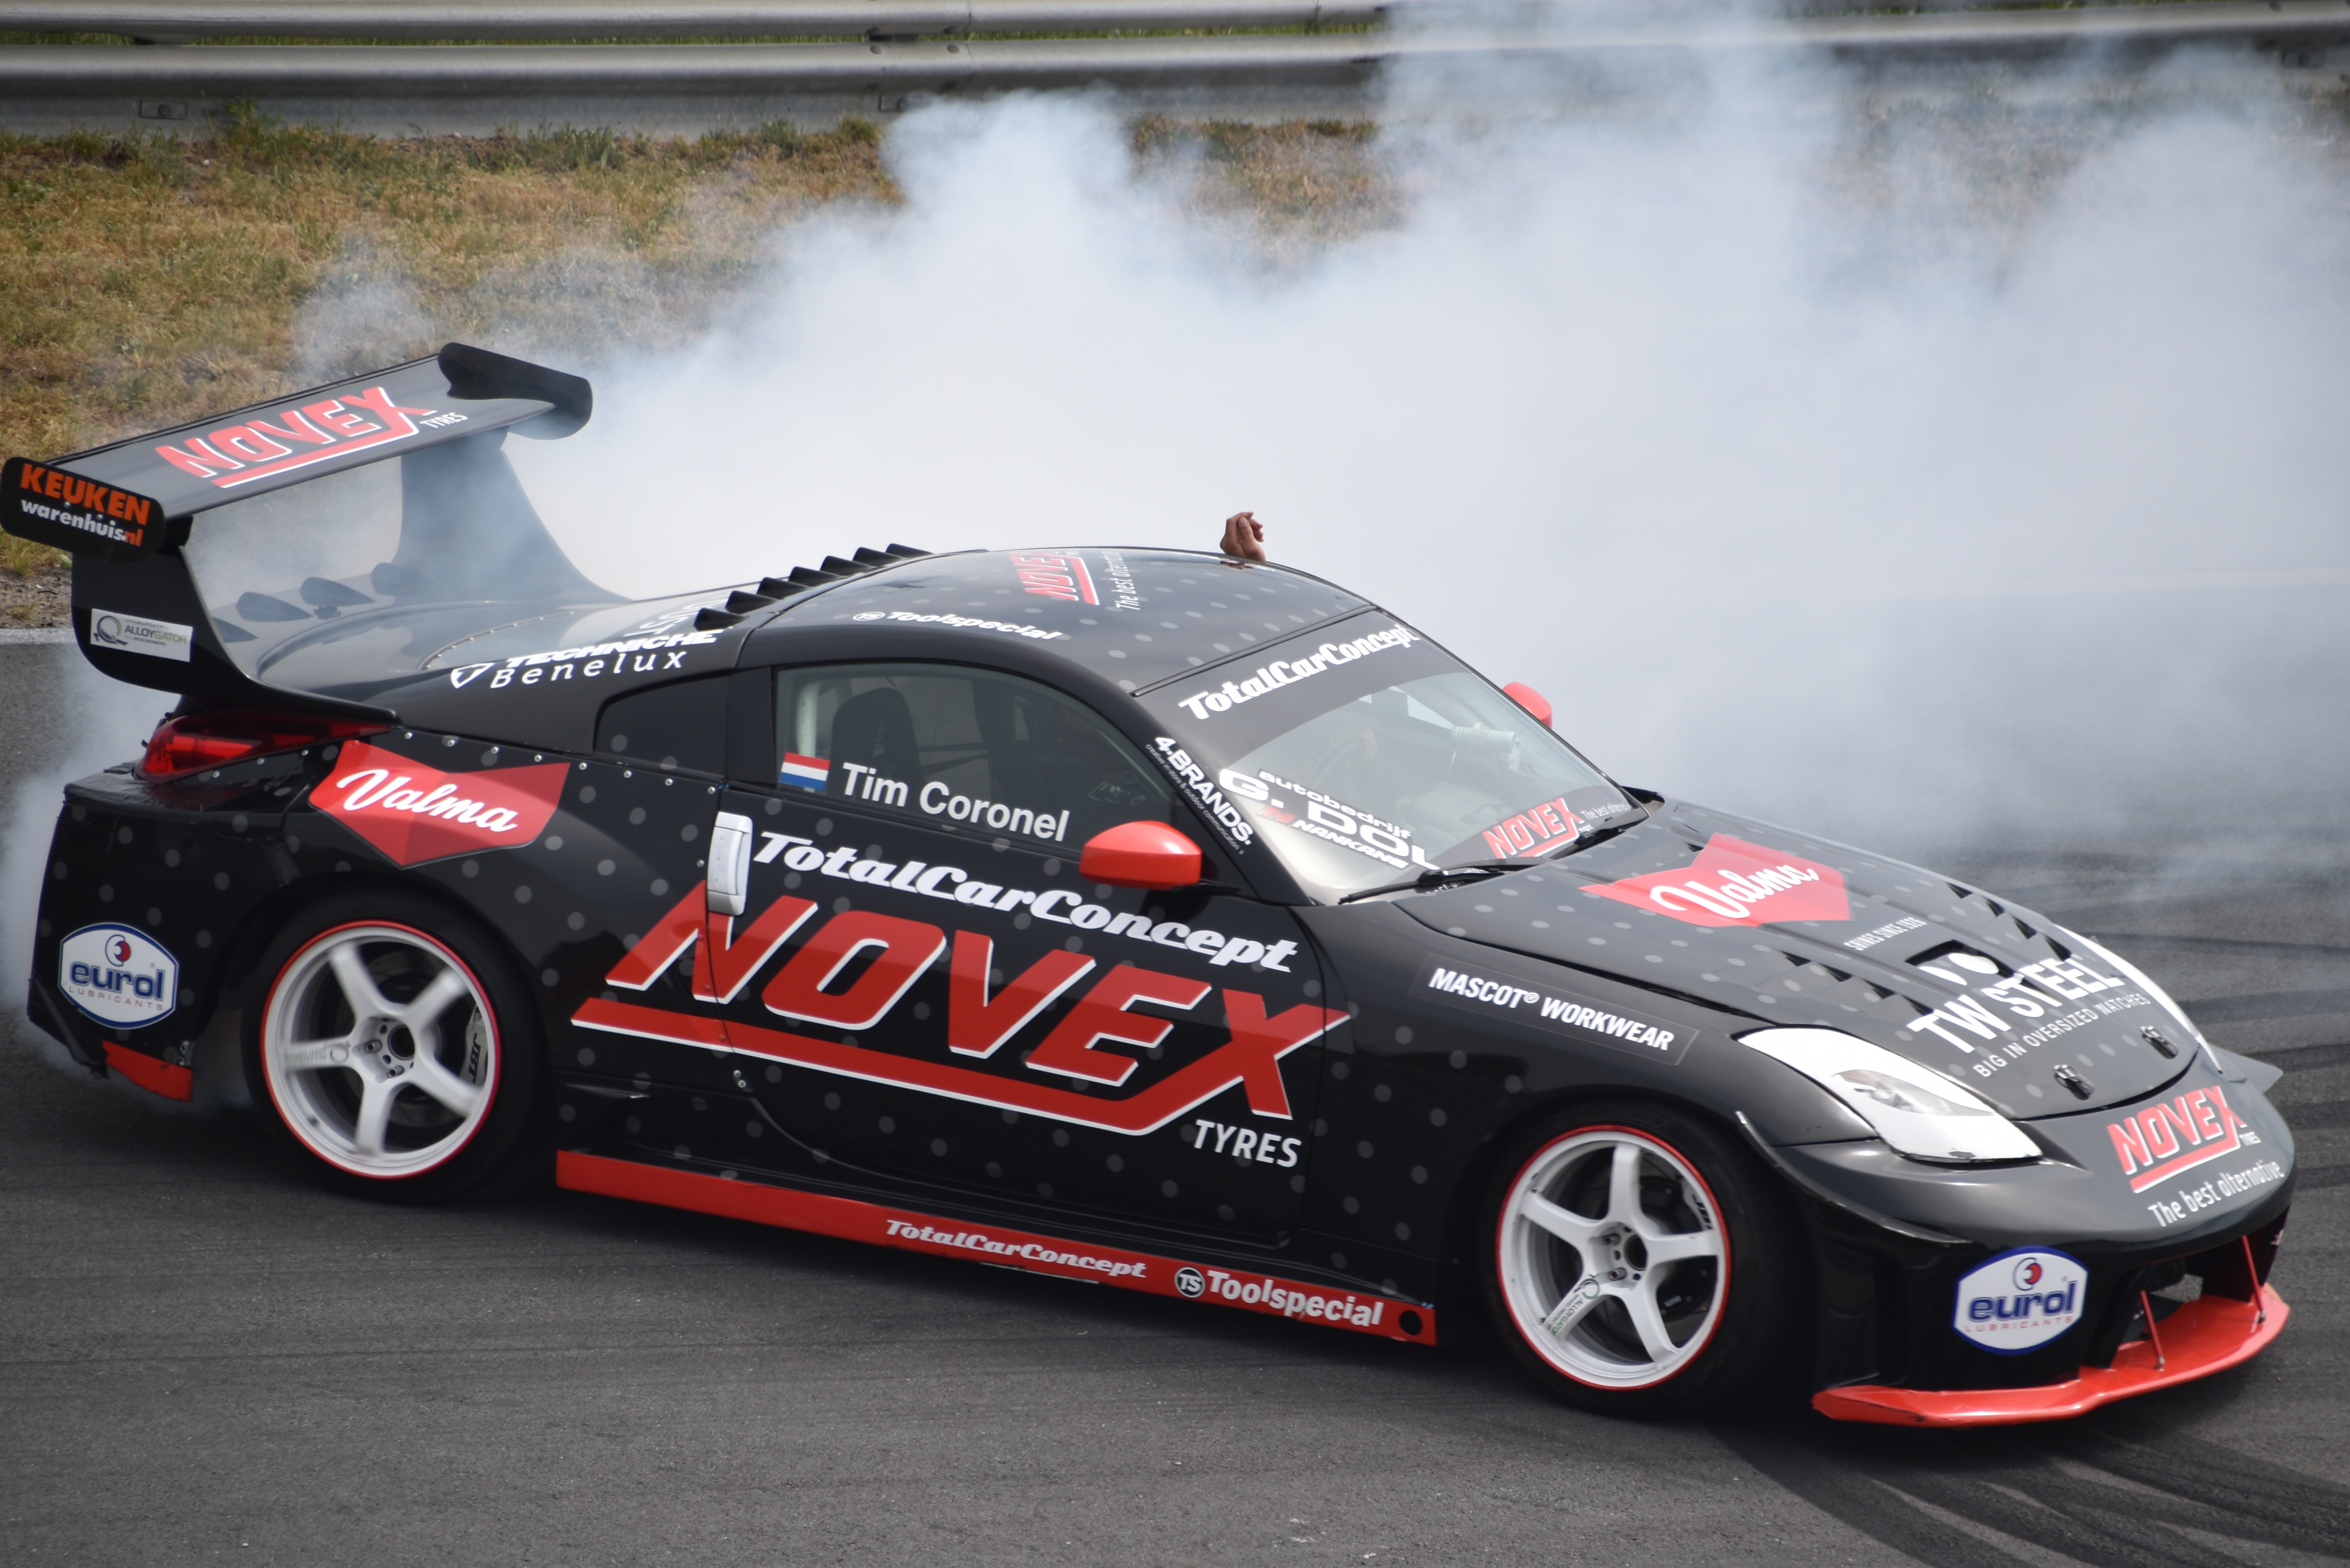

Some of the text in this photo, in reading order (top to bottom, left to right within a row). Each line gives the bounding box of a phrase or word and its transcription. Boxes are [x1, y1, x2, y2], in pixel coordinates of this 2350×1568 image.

[155, 387, 437, 478] NOVEX
[419, 412, 467, 429] TYRES
[20, 463, 151, 525] KEUKEN
[21, 499, 144, 546] warenhuis.nl
[1110, 578, 1136, 594] best
[1115, 595, 1141, 610] The
[124, 625, 187, 643] ALLOYGATOR
[506, 630, 724, 668] TECHNICHE
[888, 612, 1063, 639] Toolspecial
[490, 651, 687, 688] Benelux
[1178, 623, 1421, 720] TotalCarConcept
[336, 769, 519, 832] Valma
[843, 762, 1070, 842] Tim Coronel
[1219, 769, 1284, 809] G.
[1259, 769, 1412, 839] autobedrijf
[1184, 789, 1205, 810] outdoor
[1203, 810, 1240, 850] communication
[1292, 819, 1410, 869] NANKANG
[1483, 798, 1585, 859] NOVEX
[753, 832, 1299, 974] TotalCarConcept
[1650, 864, 1820, 918] Valma
[69, 986, 163, 1011] LUBRICANTS
[70, 961, 165, 1002] eurol
[604, 879, 1352, 1121] NOVEX
[1906, 957, 2126, 1054] TW STEEL
[1540, 997, 1674, 1051] WORKWEAR
[1973, 993, 2151, 1077] BIG IN OVERSIZED WATCHES
[1192, 1119, 1303, 1168] TYRES
[2106, 1085, 2247, 1175] NOVEX
[2147, 1160, 2285, 1227] The best alternative
[886, 1218, 1148, 1279] TotalCarConcept
[1178, 1269, 1384, 1328] TS Toolspecial
[1965, 1316, 2073, 1332] LUBRICANTS
[1968, 1281, 2078, 1322] eurol
